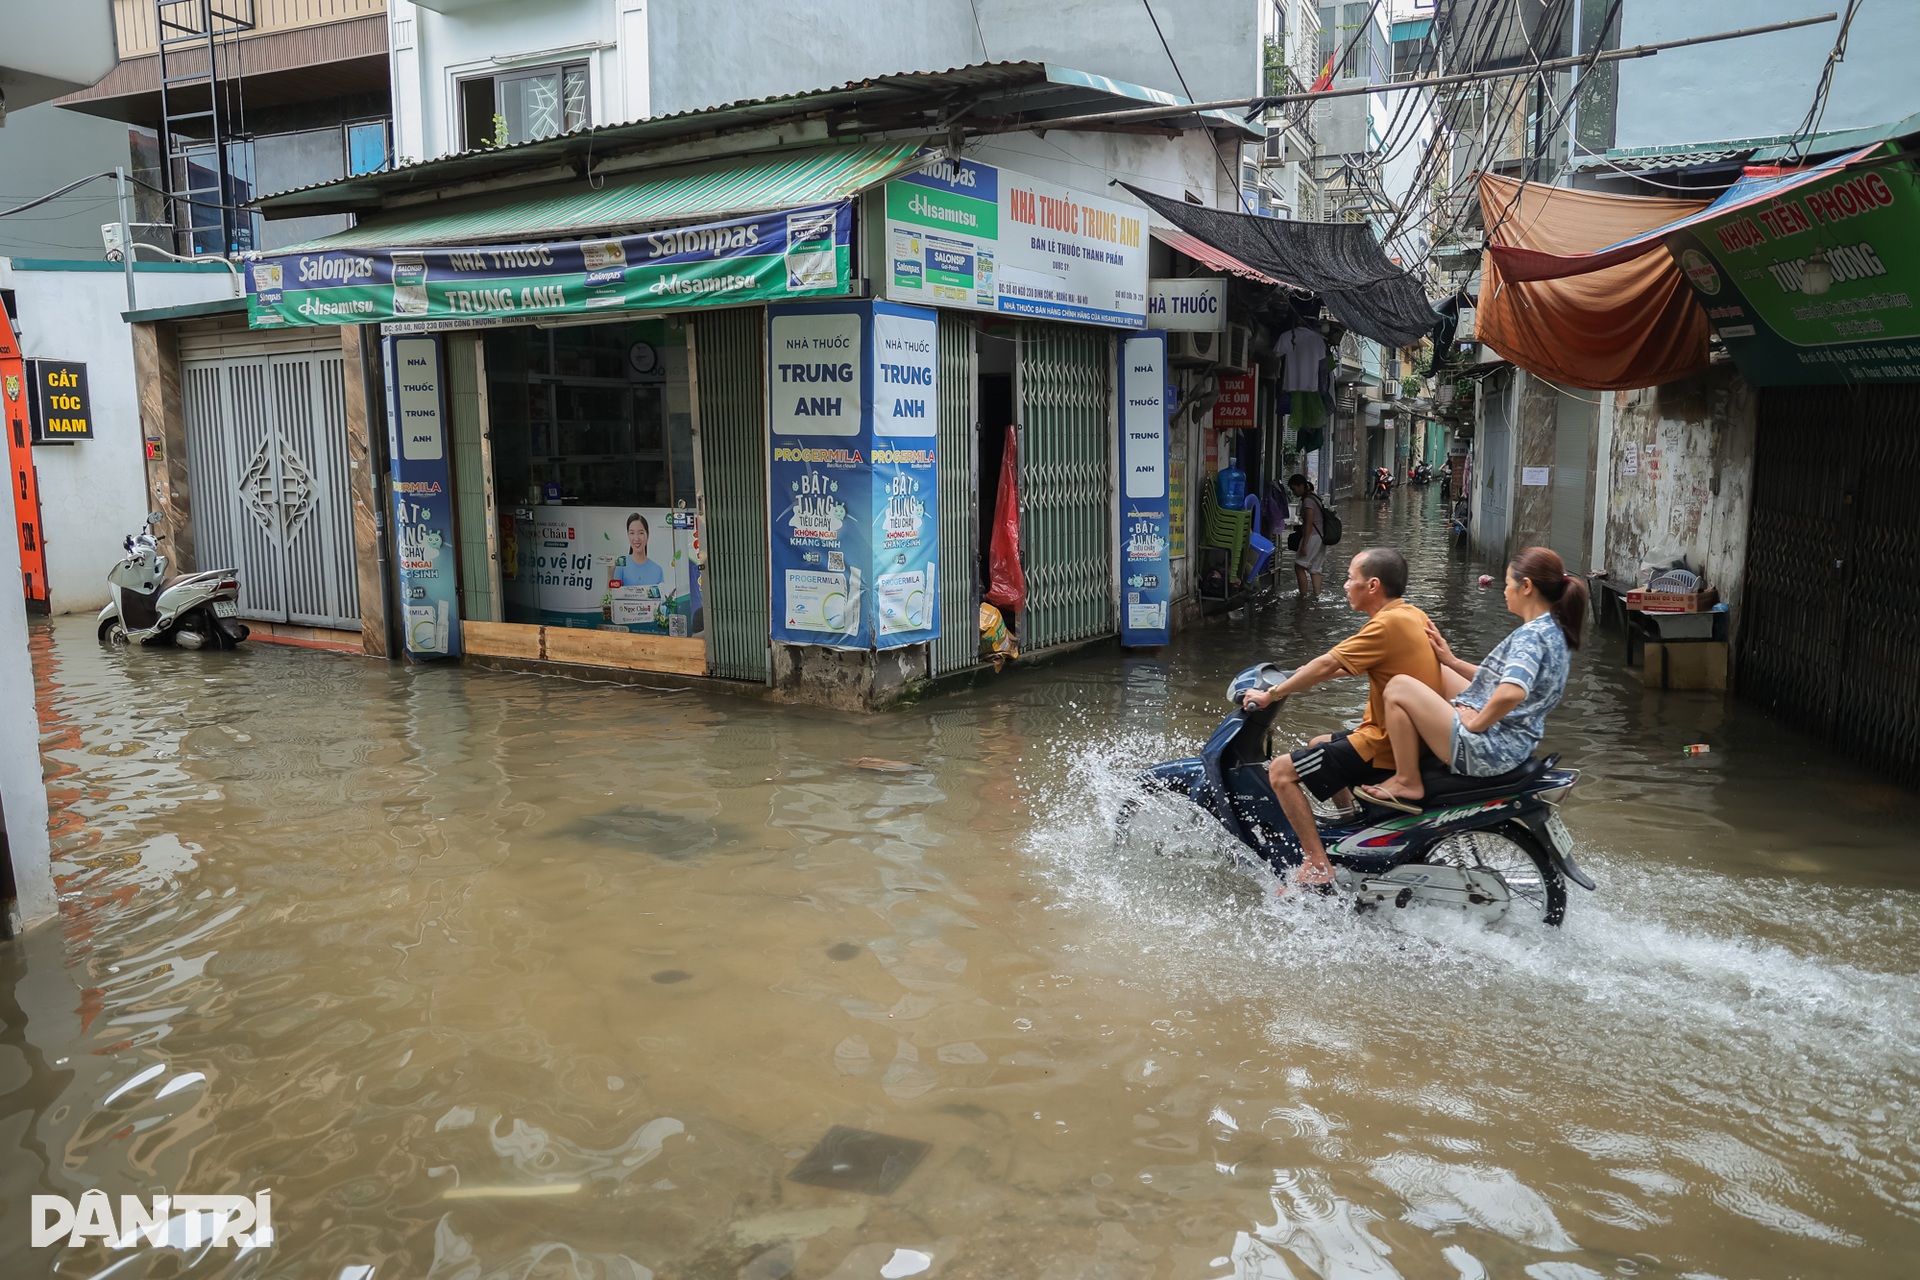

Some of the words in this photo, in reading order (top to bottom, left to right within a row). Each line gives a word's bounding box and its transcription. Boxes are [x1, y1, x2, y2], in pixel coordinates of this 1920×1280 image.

[916, 158, 975, 187] alonpas
[908, 193, 977, 228] Hisamitsu
[1010, 187, 1036, 225] NHÀ
[1039, 192, 1078, 236] THUỐC
[1082, 206, 1116, 244] TRUNG
[1120, 216, 1140, 248] ANH
[1715, 214, 1766, 255] NHỰA
[1758, 197, 1812, 240] TIỀN
[1804, 172, 1895, 226] PHONG
[648, 223, 759, 258] Salonpas
[492, 243, 554, 270] THUỐC
[1031, 237, 1046, 251] BÁN
[1057, 242, 1081, 258] THUỐC
[1082, 247, 1104, 263] THÀNH
[299, 254, 374, 283] Salonpas
[587, 270, 621, 282] Salonpas
[1767, 257, 1806, 294] TÙNG
[649, 273, 757, 296] Hisamitsu
[298, 297, 374, 316] Hisamitsu
[445, 288, 516, 313] TRUNG
[521, 285, 566, 311] ANH
[1004, 301, 1016, 311] NHÀ
[1016, 303, 1034, 313] THUỐC
[1149, 293, 1166, 314] HÀ
[1172, 289, 1217, 314] THUỐC
[786, 337, 809, 350] NHÀ
[812, 334, 850, 349] THUỐC
[885, 338, 902, 350] NHÀ
[904, 338, 930, 353] THUỐC
[407, 356, 427, 366] NHÀ
[1134, 363, 1153, 373] NHÀ
[48, 368, 78, 388] CẮT
[778, 363, 853, 383] TRUNG
[880, 363, 932, 386] TRUNG
[403, 381, 434, 392] THUỐC
[1224, 380, 1245, 390] TAXI
[50, 393, 81, 410] TÓC
[1129, 396, 1160, 406] THUỐC
[1219, 394, 1231, 403] XE
[1234, 392, 1250, 403] ÔM
[794, 397, 842, 416] ANH
[892, 398, 925, 418] ANH
[1220, 407, 1247, 416] 24/24
[49, 418, 87, 432] NAM
[413, 435, 432, 443] ANH
[1130, 432, 1159, 440] TRUNG
[774, 448, 863, 464] PROGERMILA
[871, 450, 935, 464] PROGERMILA
[1135, 465, 1155, 473] ANH
[801, 470, 830, 498] BẬT
[892, 471, 913, 498] BẬT
[542, 527, 567, 540] Châu
[794, 527, 819, 537] KHÔNG
[1135, 520, 1154, 535] BẬT
[789, 536, 820, 547] KHÁNG
[821, 539, 841, 549] SINH
[883, 538, 905, 550] KHÁNG
[906, 539, 921, 549] SINH
[550, 552, 568, 573] vệ
[571, 553, 592, 574] lợi
[413, 570, 439, 578] SINH
[563, 572, 593, 591] răng
[789, 574, 841, 586] PROGERMILA
[882, 574, 920, 586] PROGERMILA
